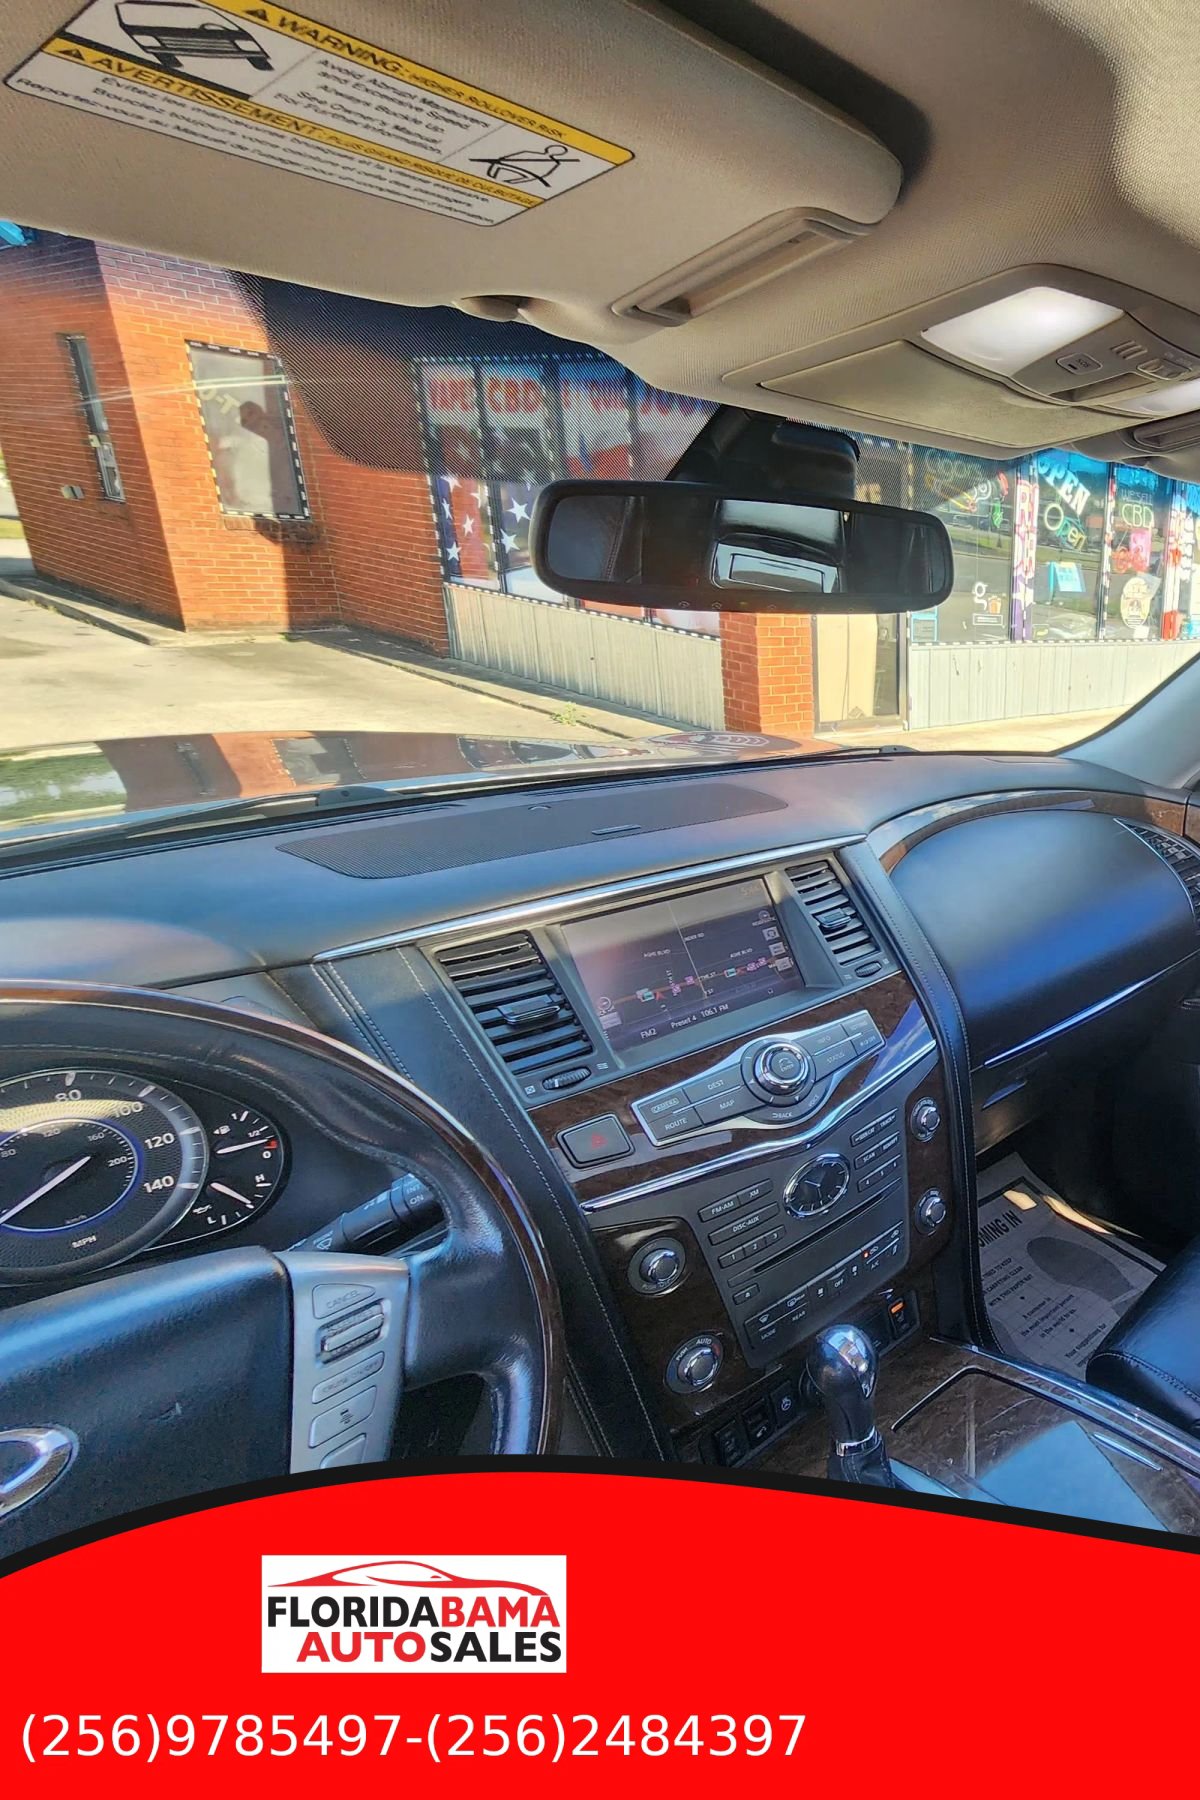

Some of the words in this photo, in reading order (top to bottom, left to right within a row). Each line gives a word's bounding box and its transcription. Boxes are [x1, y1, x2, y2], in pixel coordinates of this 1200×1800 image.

[278, 16, 409, 76] WARNING:
[486, 377, 541, 413] CBD
[1121, 503, 1154, 528] CBD
[640, 1028, 657, 1039] FM2
[671, 1017, 690, 1028] Preset
[701, 1008, 718, 1018] 106.1
[719, 1003, 729, 1012] FM
[707, 1079, 725, 1090] DEST
[55, 1089, 82, 1102] 80
[112, 1101, 144, 1118] 100
[719, 1099, 735, 1110] MAP
[779, 1111, 793, 1119] BACK
[664, 1117, 687, 1131] ROUTE
[43, 1127, 61, 1137] 120
[88, 1132, 105, 1142] 160
[247, 1129, 261, 1138] 1/2
[144, 1132, 175, 1150] 120
[108, 1155, 128, 1167] 200
[143, 1175, 175, 1193] 140
[254, 1173, 265, 1183] H
[409, 1194, 425, 1206] ON
[749, 1189, 760, 1198] XM
[206, 1216, 217, 1225] L
[978, 1217, 1010, 1248] OMING
[1002, 1209, 1023, 1229] IN
[71, 1234, 97, 1249] MPH
[752, 1243, 759, 1251] 2
[772, 1232, 778, 1240] 3
[325, 1289, 361, 1309] CANCEL
[675, 1346, 689, 1362] PUSH
